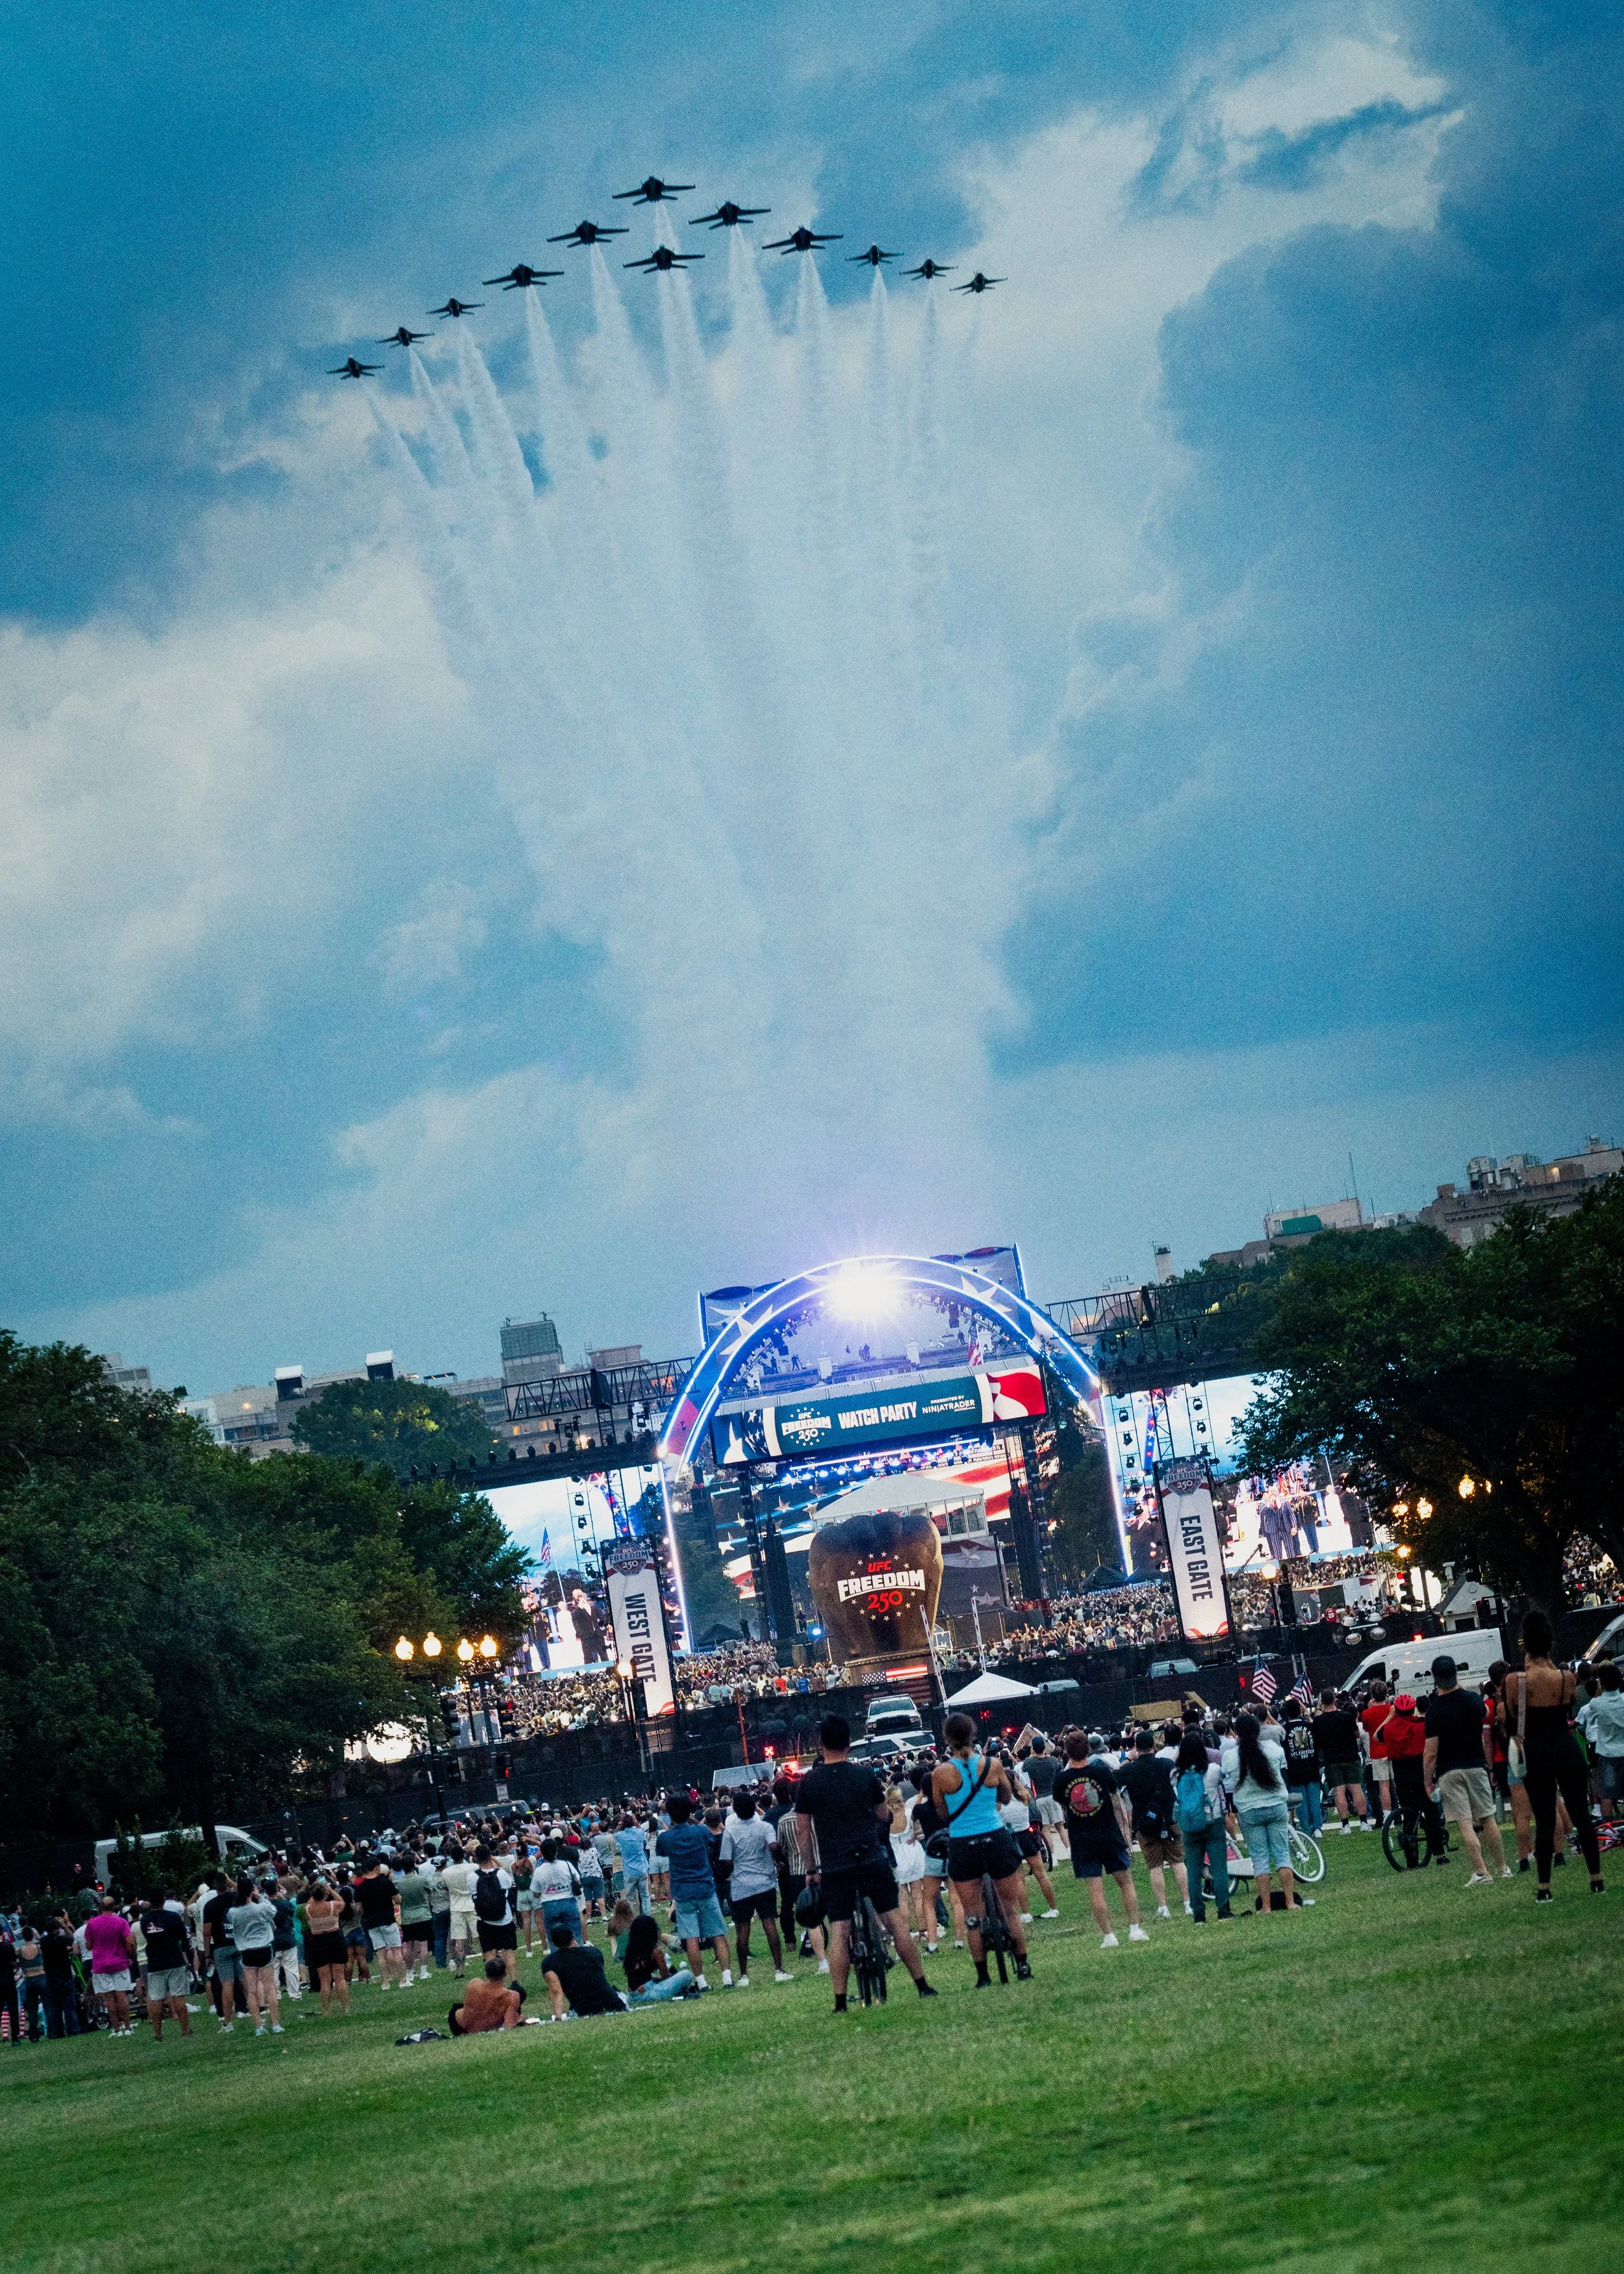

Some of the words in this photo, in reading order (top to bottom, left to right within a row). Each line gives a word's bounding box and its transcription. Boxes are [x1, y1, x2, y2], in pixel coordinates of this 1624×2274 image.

[837, 1407, 880, 1429] WATCH
[880, 1401, 917, 1423] PARTY
[922, 1399, 975, 1414] NINJATRADER
[781, 1416, 831, 1436] FREEDOM
[798, 1428, 818, 1442] 250
[1163, 1469, 1204, 1485] FREEDOM
[1176, 1480, 1193, 1490] 250
[1180, 1514, 1206, 1555] EAST
[608, 1550, 650, 1566] FREEDOM
[622, 1560, 639, 1570] 250
[867, 1560, 892, 1572] UFC
[837, 1569, 926, 1603] FREEDOM
[1187, 1559, 1213, 1602] GATE
[867, 1591, 903, 1613] 250
[624, 1592, 650, 1639] WEST
[631, 1642, 657, 1683] GATE
